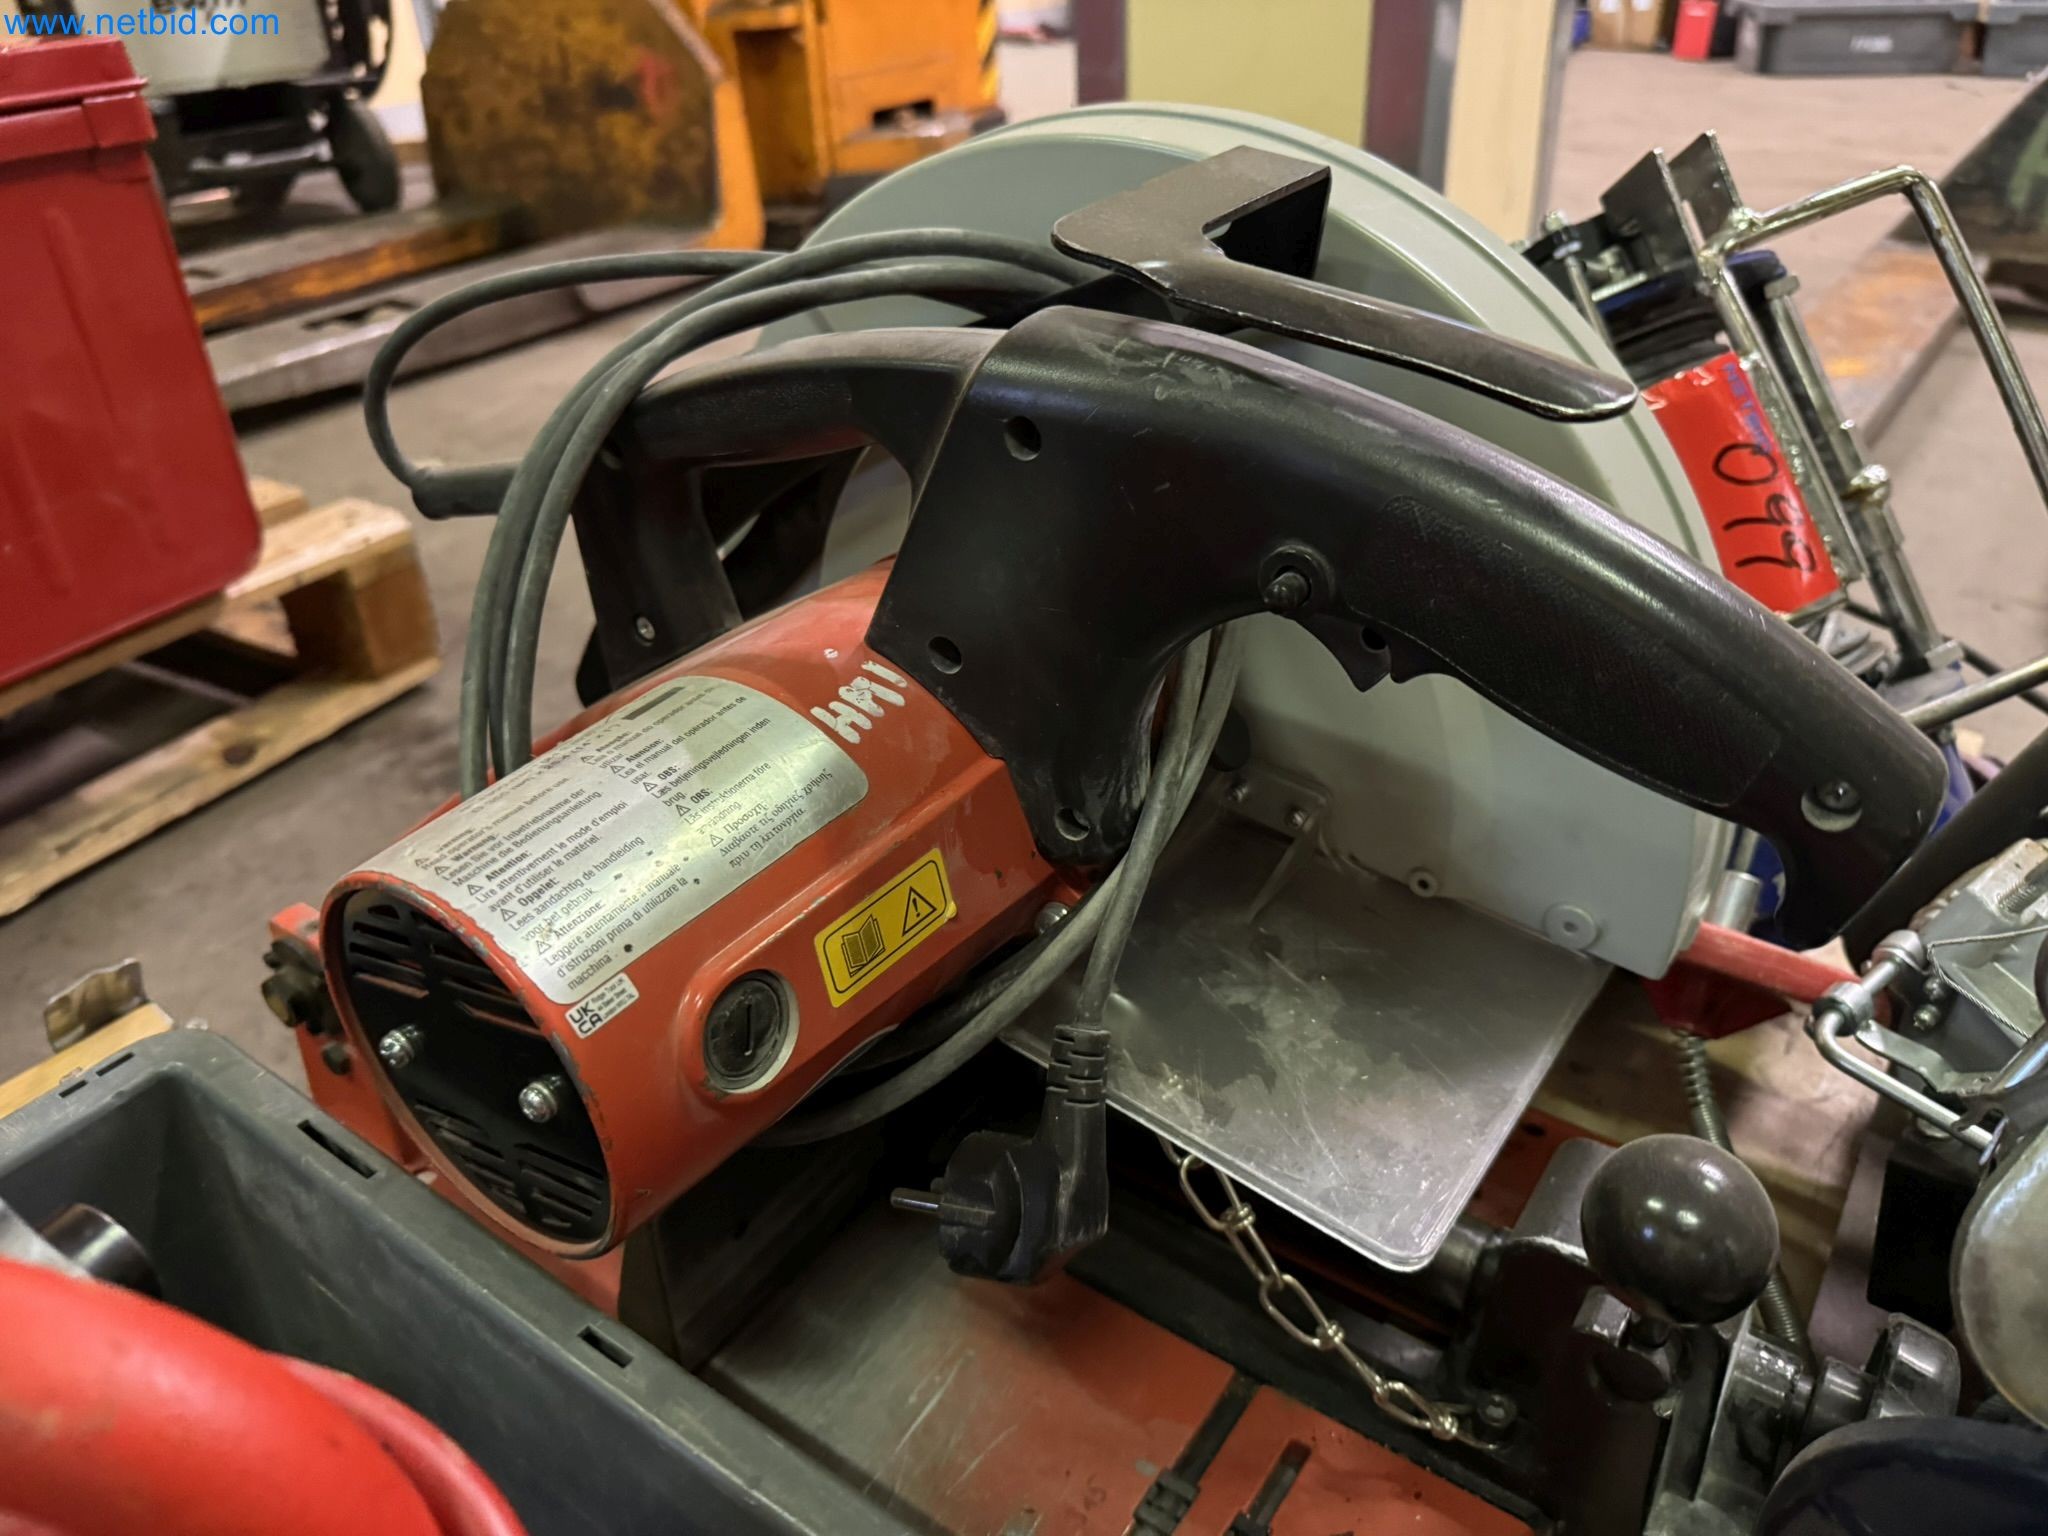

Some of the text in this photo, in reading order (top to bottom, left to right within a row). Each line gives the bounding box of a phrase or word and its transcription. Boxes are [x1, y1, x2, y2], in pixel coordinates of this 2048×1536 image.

[618, 766, 636, 780] Lea
[644, 741, 673, 764] manual
[683, 715, 716, 738] operador
[715, 702, 736, 717] antes
[734, 695, 747, 705] de
[748, 717, 771, 734] inden
[630, 768, 652, 786] usar.
[657, 764, 681, 781] OBS:
[662, 790, 686, 807] brug.
[688, 786, 713, 805] OBS:
[441, 787, 586, 882] Lesen Sie vor Inbetriebnahme der
[452, 790, 602, 887] Maschine die Bedienungsanleitung.
[475, 799, 628, 904] Lire attentivement le mode d'emploi
[484, 850, 532, 883] Attention:
[489, 832, 602, 914] avant d'utiliser le matériel.
[508, 836, 645, 933] Lees aandachtig de handleiding
[517, 877, 559, 907] Opgelet:
[552, 899, 606, 941] Attenzione:
[554, 876, 688, 979] d'istruzioni prima di utilizzare la
[543, 936, 584, 967] Leggere
[569, 1001, 595, 1024] UK
[578, 1013, 603, 1034] CA
